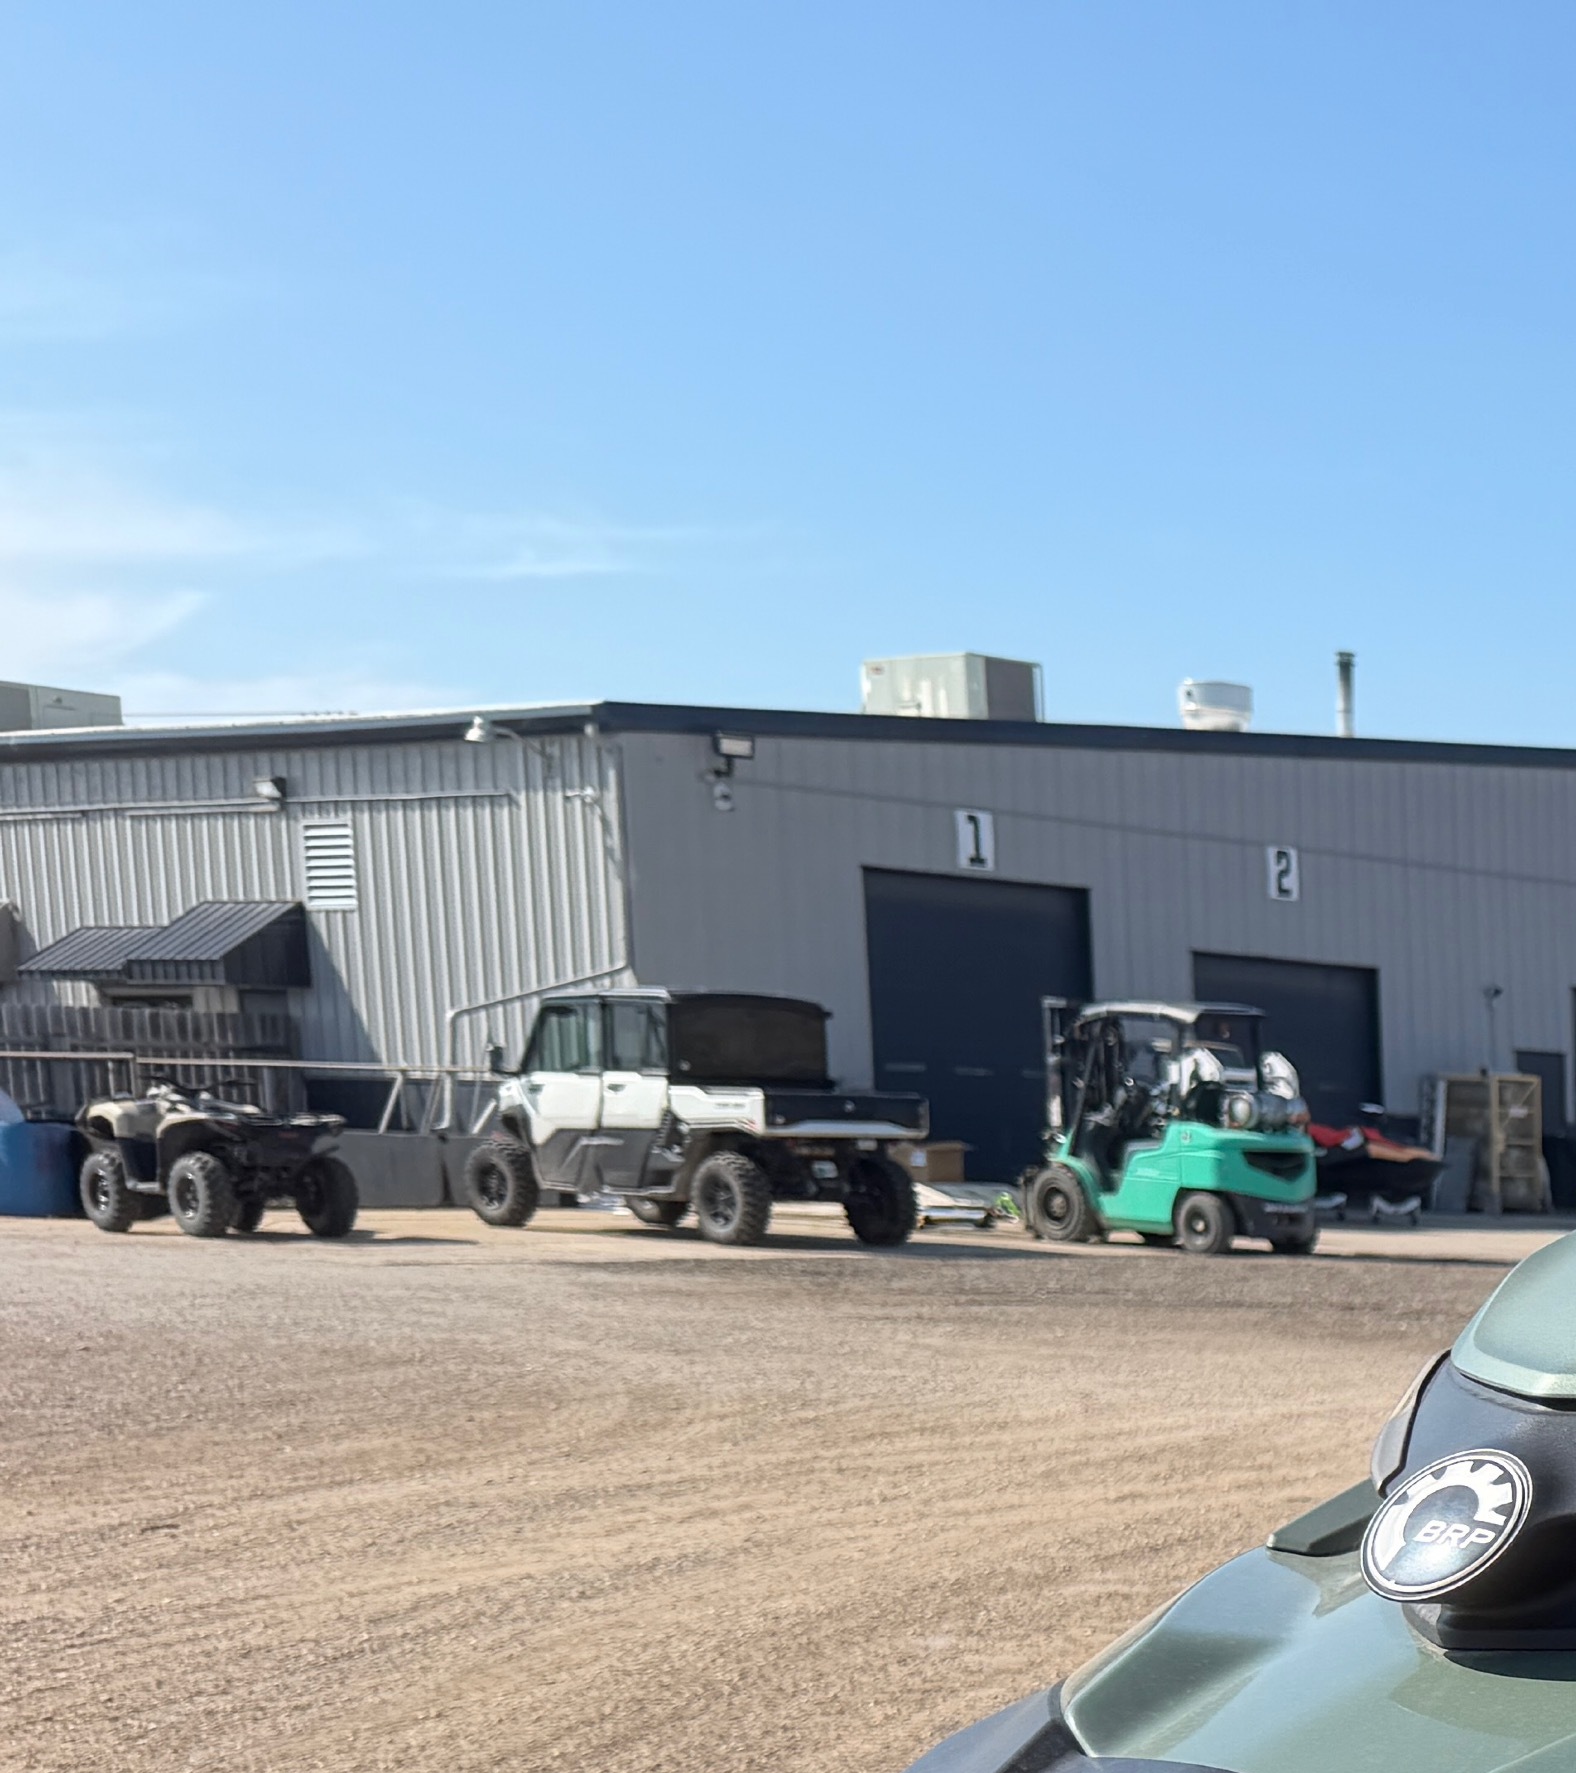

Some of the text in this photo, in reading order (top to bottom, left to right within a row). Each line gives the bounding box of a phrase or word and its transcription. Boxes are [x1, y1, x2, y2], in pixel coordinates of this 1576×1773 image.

[966, 813, 987, 868] 1
[1275, 850, 1293, 897] 2
[1414, 1519, 1496, 1549] BRP
